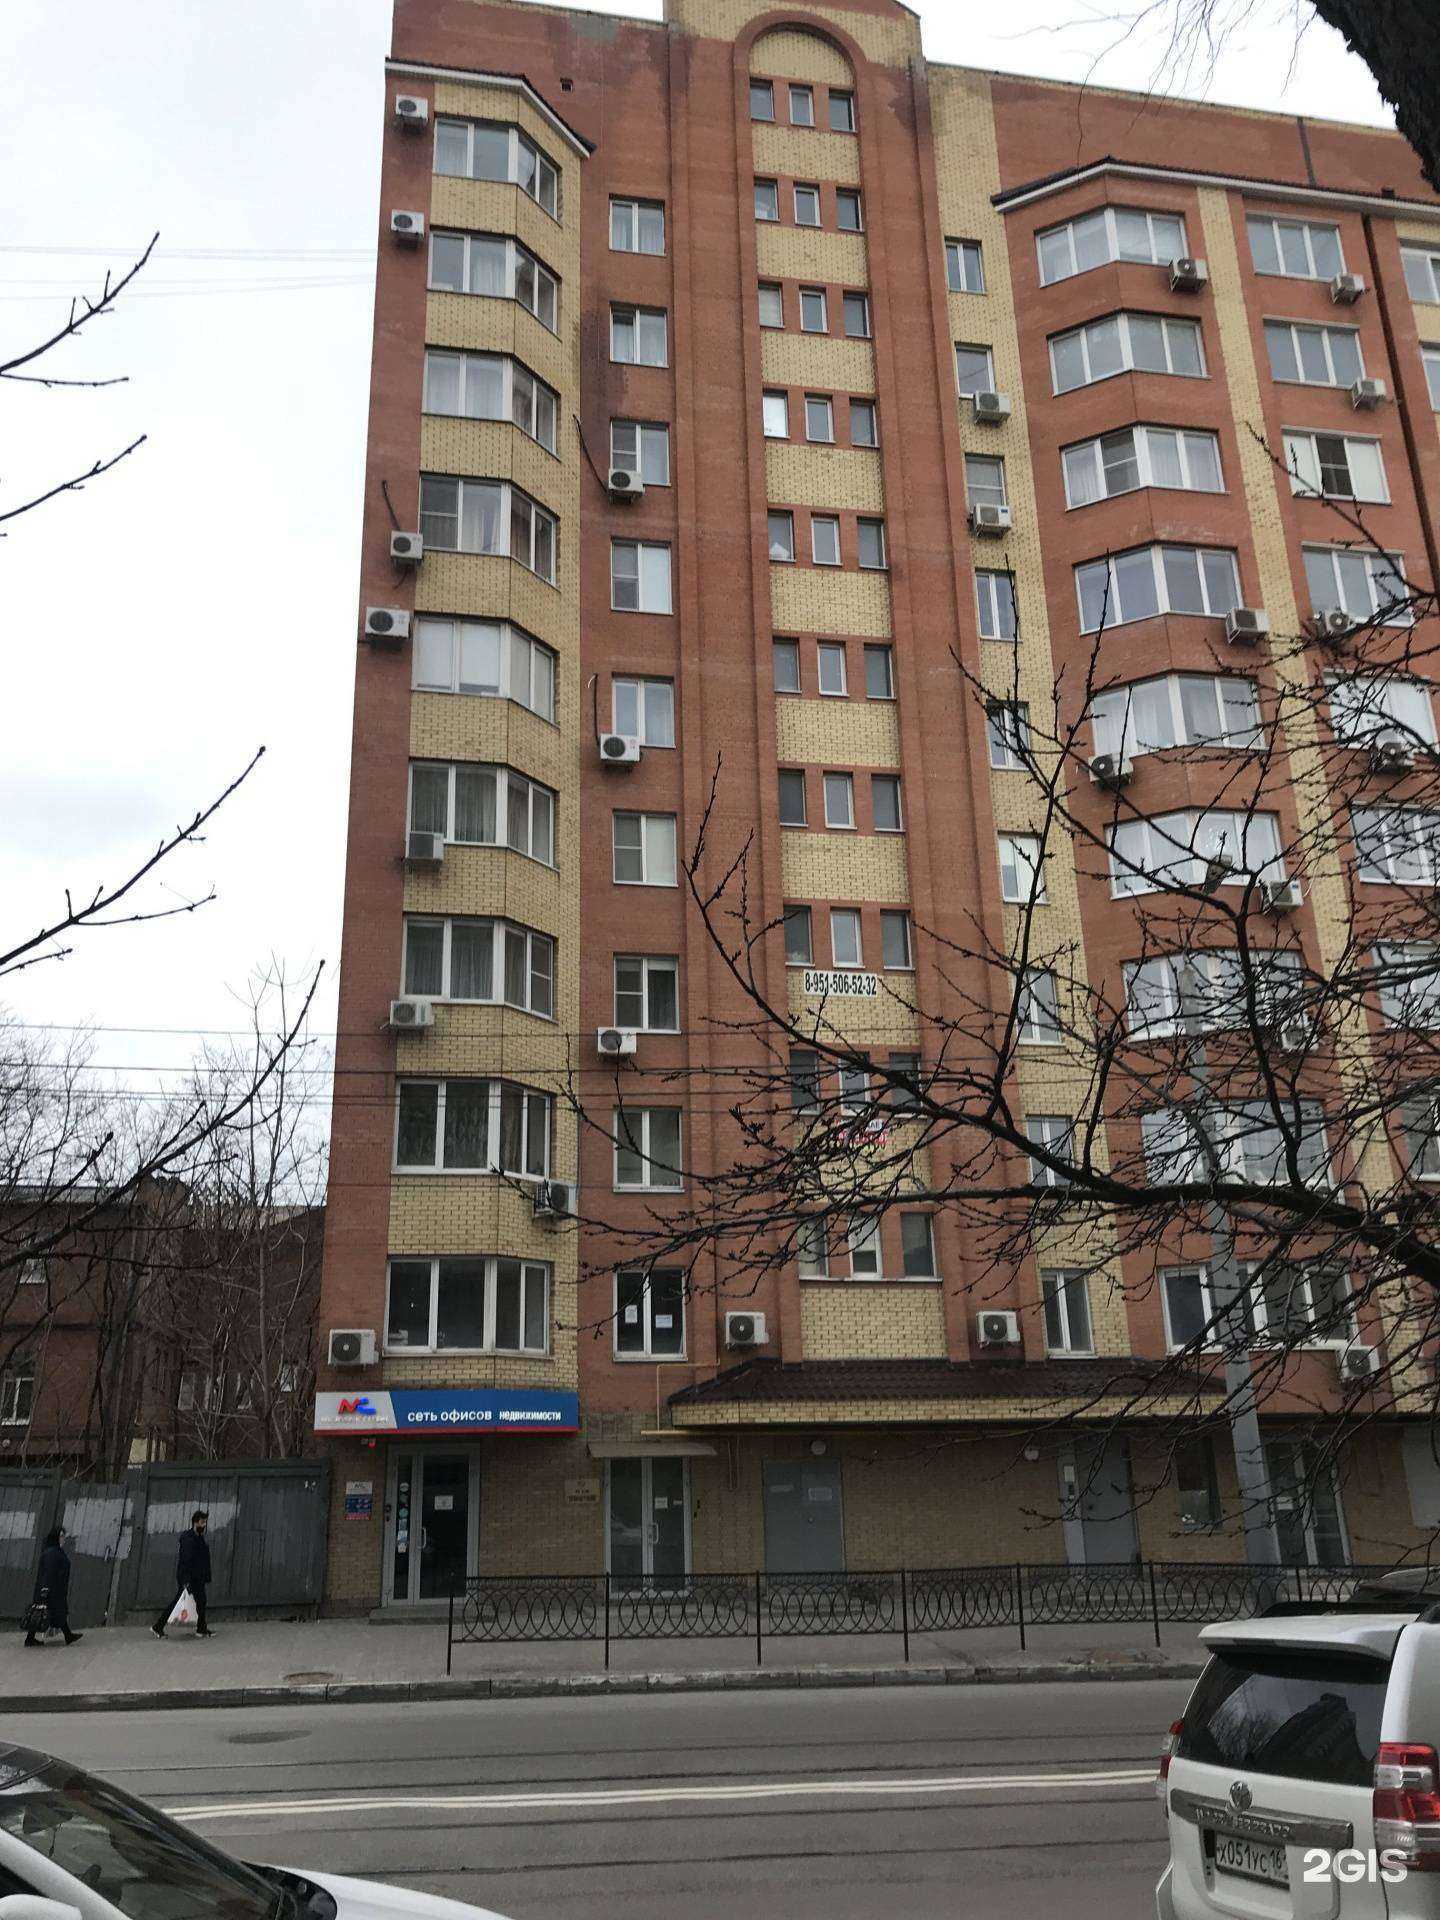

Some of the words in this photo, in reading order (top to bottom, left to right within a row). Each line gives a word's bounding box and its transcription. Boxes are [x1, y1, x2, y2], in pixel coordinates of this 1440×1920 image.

[805, 972, 877, 996] 8-951-506-52-32
[407, 1410, 438, 1422] сеть
[440, 1408, 492, 1423] офисов
[499, 1410, 561, 1422] недвижимости
